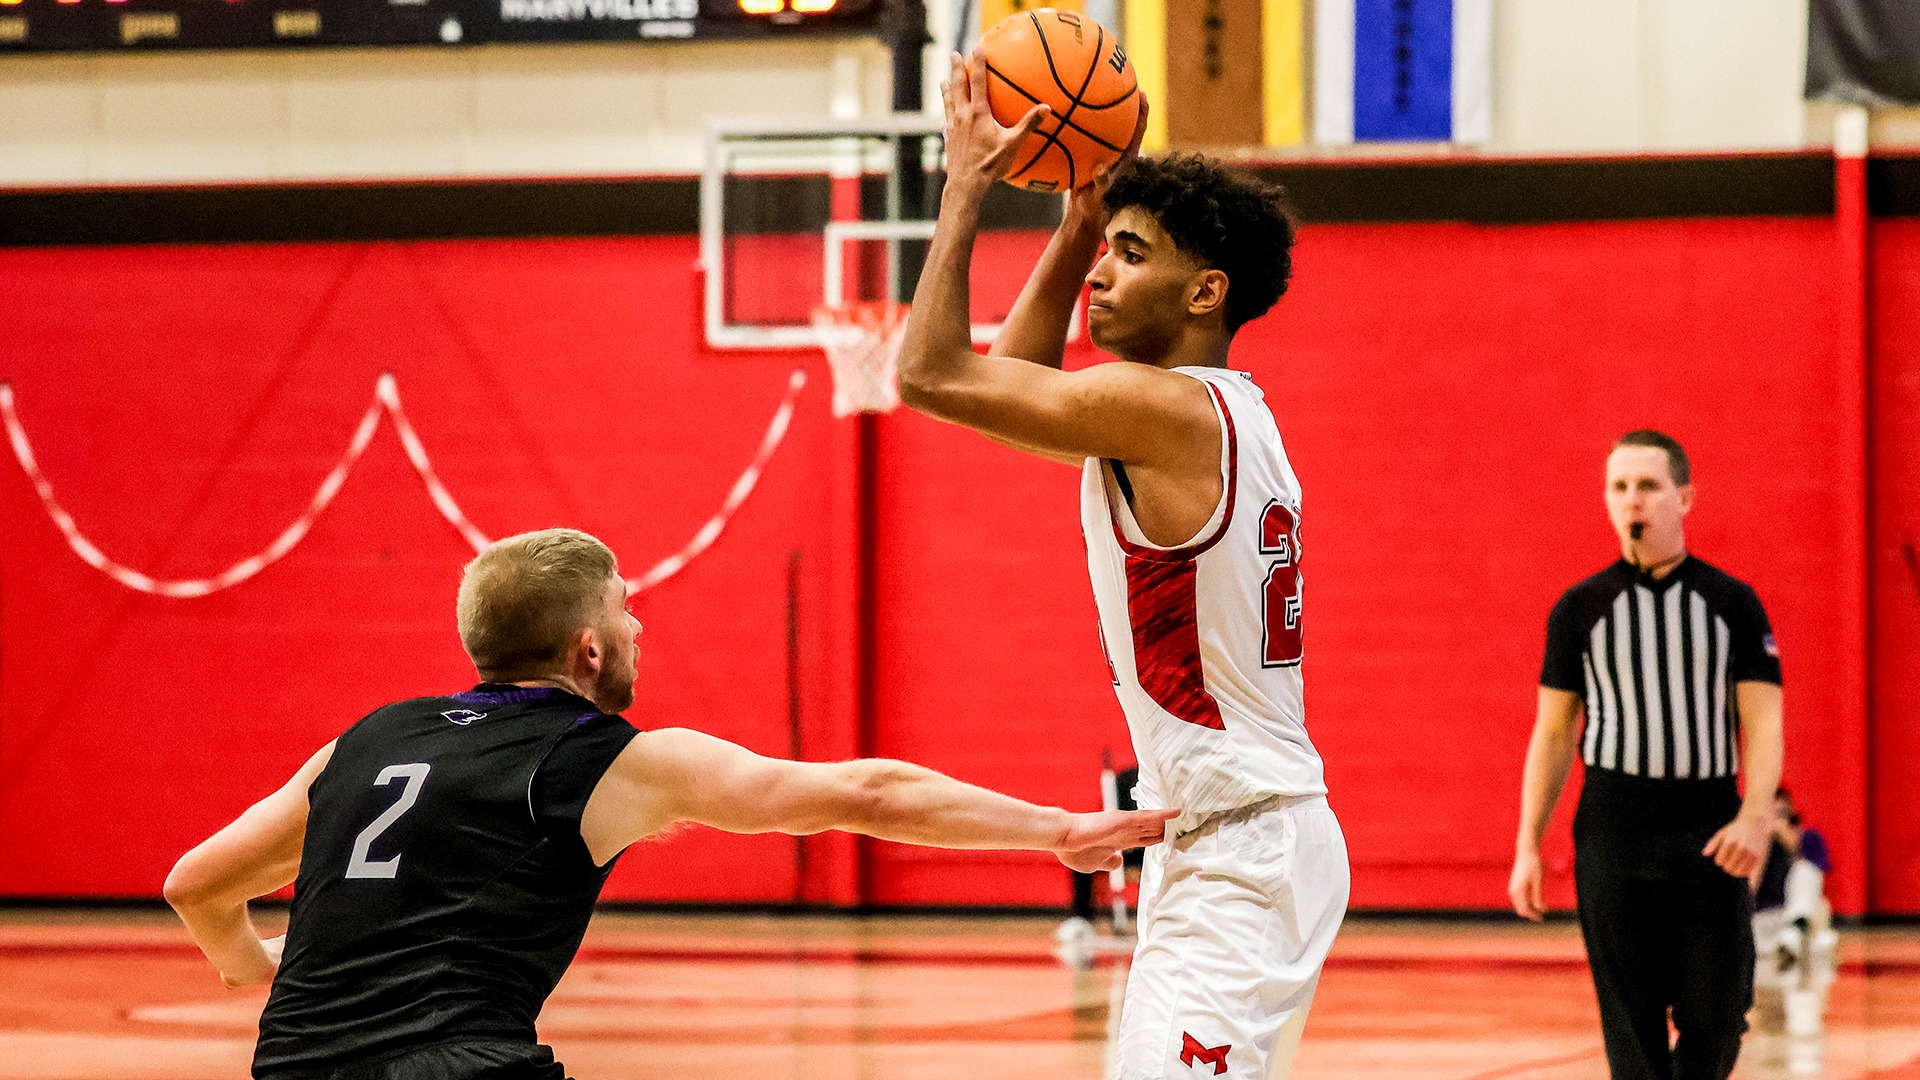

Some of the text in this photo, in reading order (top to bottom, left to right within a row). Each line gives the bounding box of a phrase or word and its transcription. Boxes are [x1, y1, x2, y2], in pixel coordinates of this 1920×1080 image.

[1258, 497, 1303, 669] 2
[345, 762, 431, 879] 2
[1180, 1030, 1232, 1076] M
